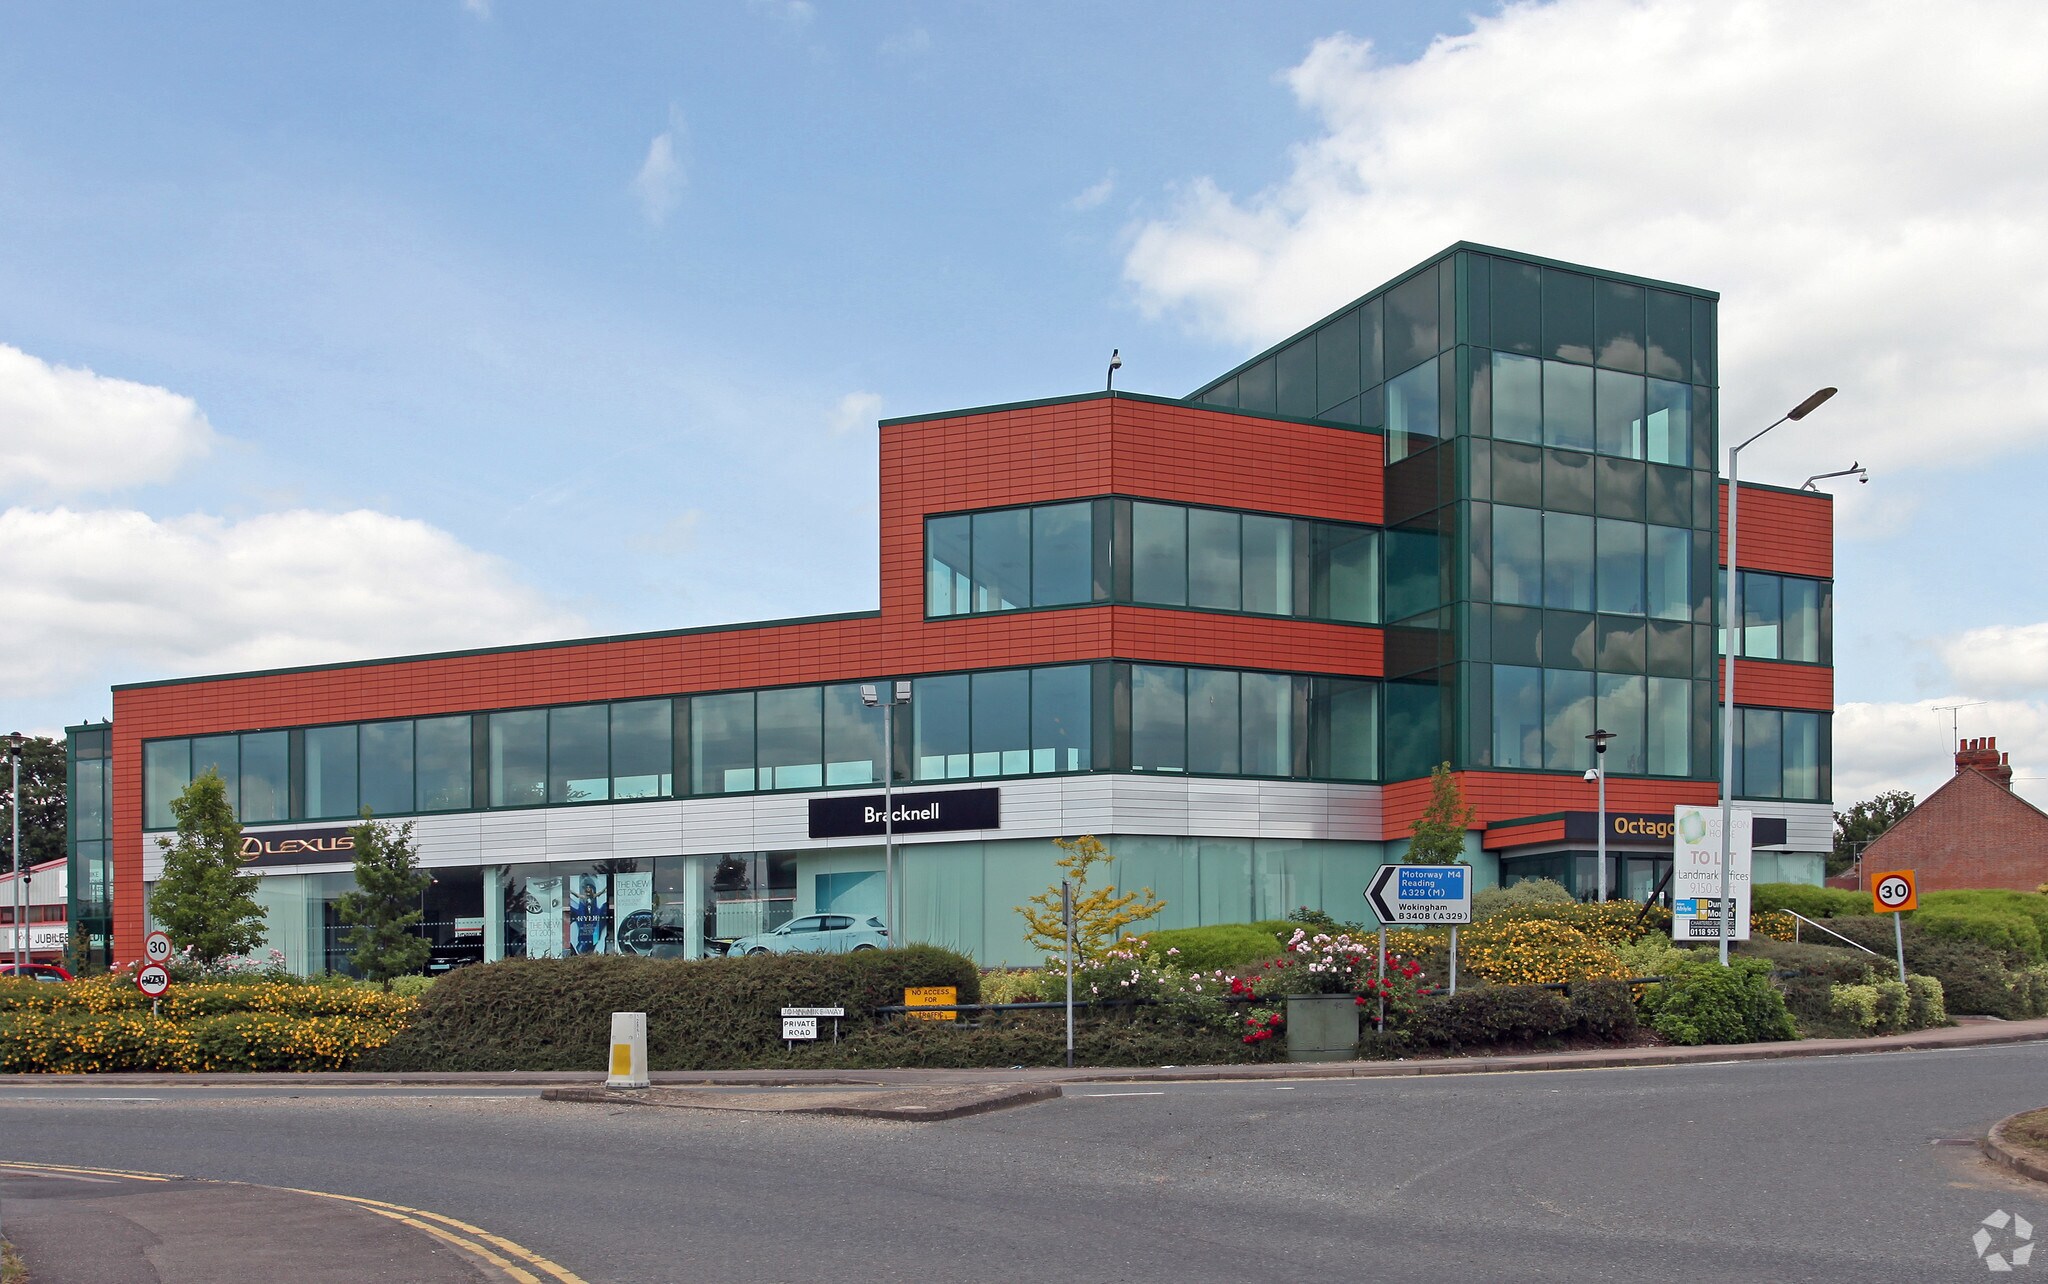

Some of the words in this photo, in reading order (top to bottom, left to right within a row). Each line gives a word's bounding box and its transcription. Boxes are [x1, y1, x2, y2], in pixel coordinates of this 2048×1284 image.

[1614, 817, 1674, 838] Octago
[1709, 819, 1750, 829] OCGON
[1709, 829, 1736, 838] HOE
[265, 836, 355, 854] LEXUS
[1690, 851, 1710, 865] TO
[1714, 851, 1737, 865] LT
[1402, 870, 1443, 879] Motorway
[1678, 869, 1719, 880] Landmark
[1402, 880, 1435, 888] Reading
[1428, 888, 1446, 897] (M)
[1881, 884, 1907, 898] 30
[1399, 903, 1448, 911] Wokingham
[1708, 900, 1735, 908] Duner
[1399, 912, 1430, 920] B3408
[1433, 912, 1468, 920] (A329)
[1690, 928, 1706, 936] 0118
[1707, 928, 1719, 936] 955
[149, 941, 167, 953] 30
[923, 988, 950, 996] ACCESS
